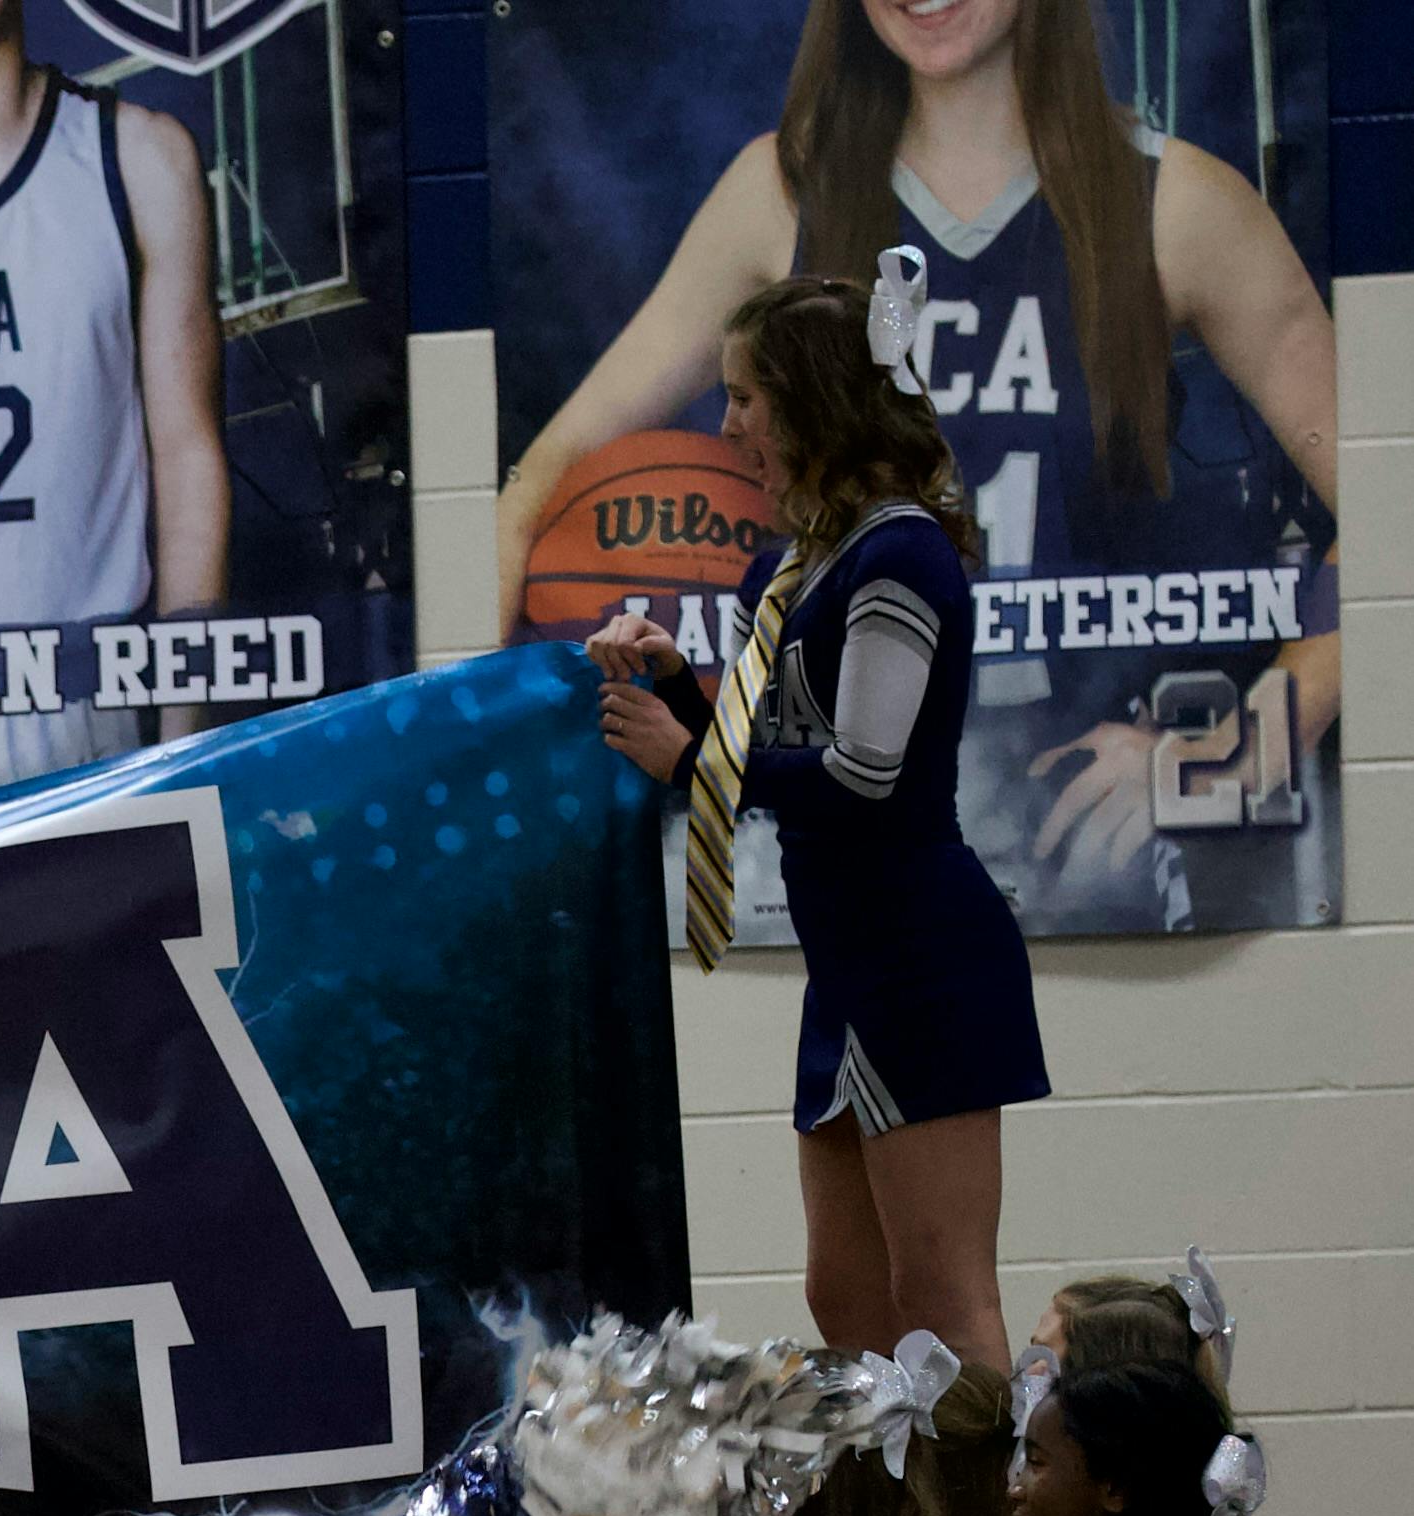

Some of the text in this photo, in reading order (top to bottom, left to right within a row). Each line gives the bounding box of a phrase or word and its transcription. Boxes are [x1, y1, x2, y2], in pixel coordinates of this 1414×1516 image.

[914, 295, 1060, 416] CA
[593, 491, 759, 553] Wilso
[971, 566, 1303, 655] ETERSEN
[975, 450, 1054, 707] 1
[91, 614, 325, 710] REED
[1150, 667, 1304, 829] 21
